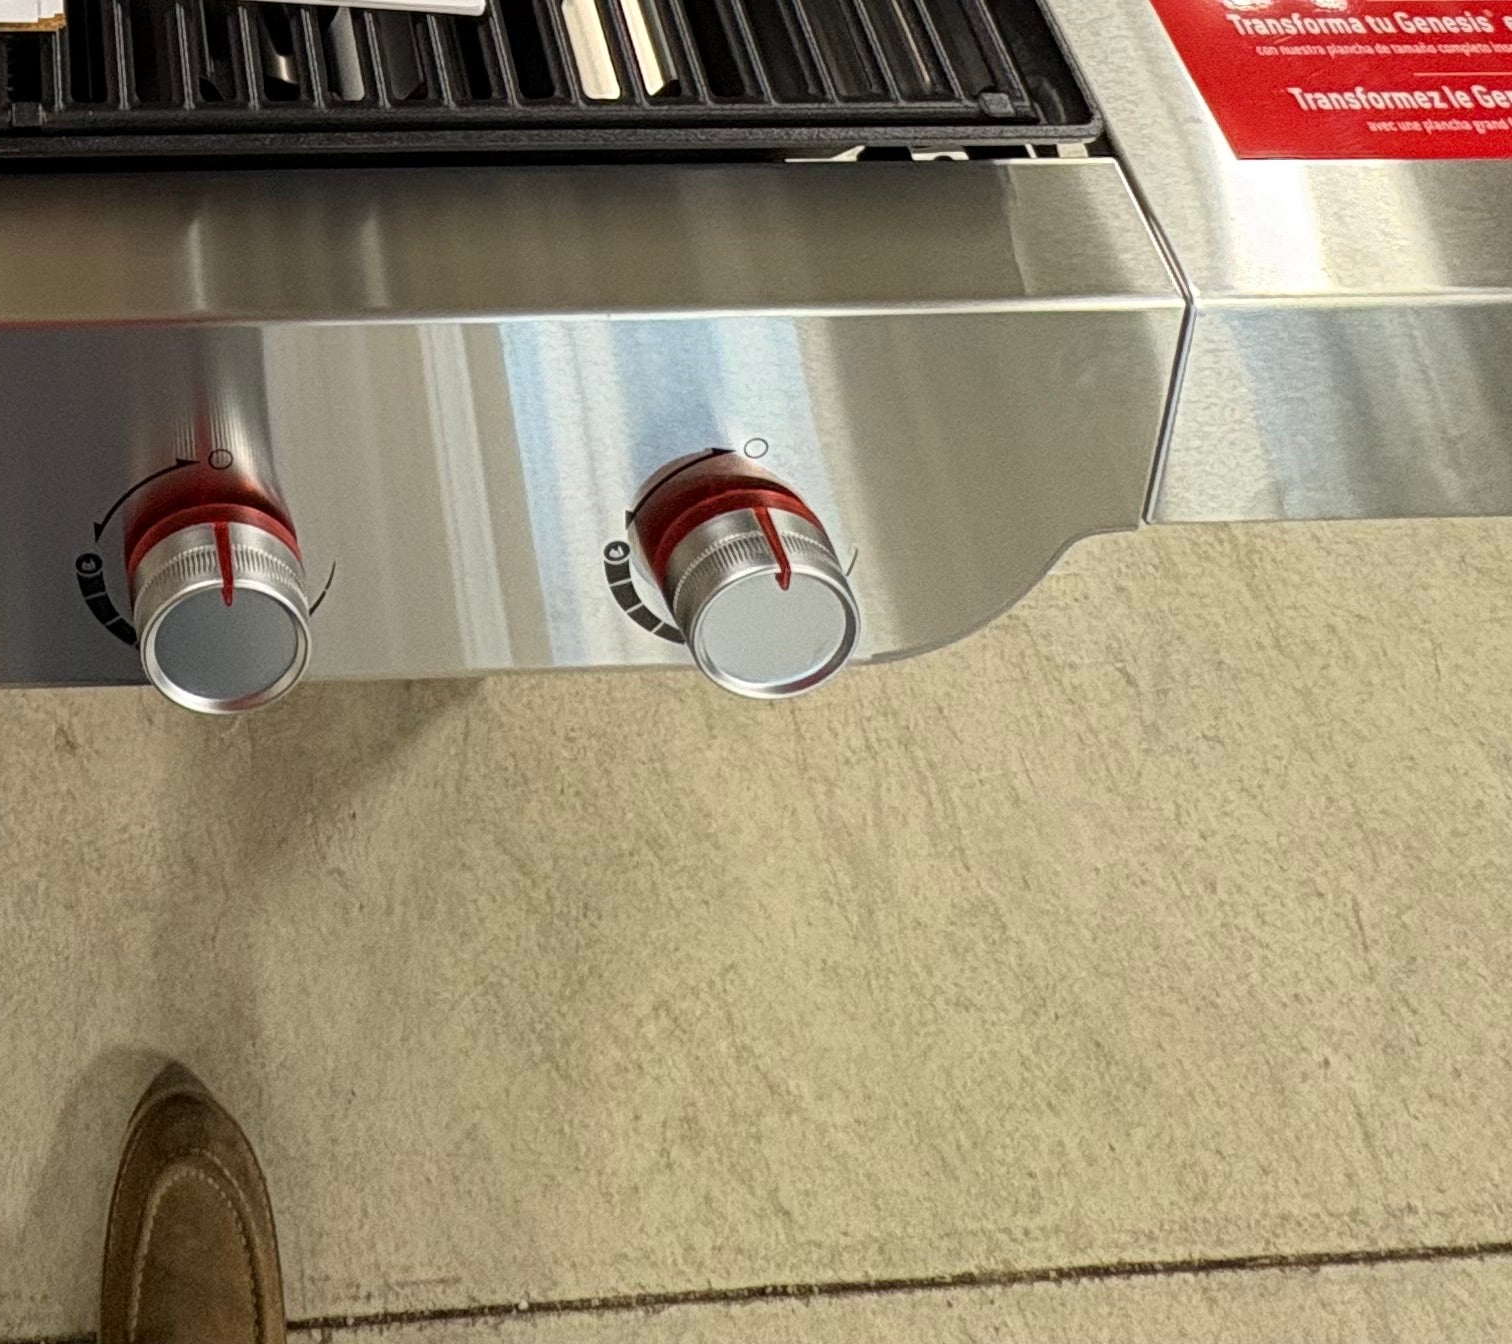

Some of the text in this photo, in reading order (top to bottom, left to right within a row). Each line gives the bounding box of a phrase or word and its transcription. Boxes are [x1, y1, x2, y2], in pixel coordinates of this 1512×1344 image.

[1225, 13, 1367, 35] Transforma
[1364, 15, 1397, 34] tu
[1286, 86, 1449, 111] Transformez
[1441, 85, 1475, 109] le
